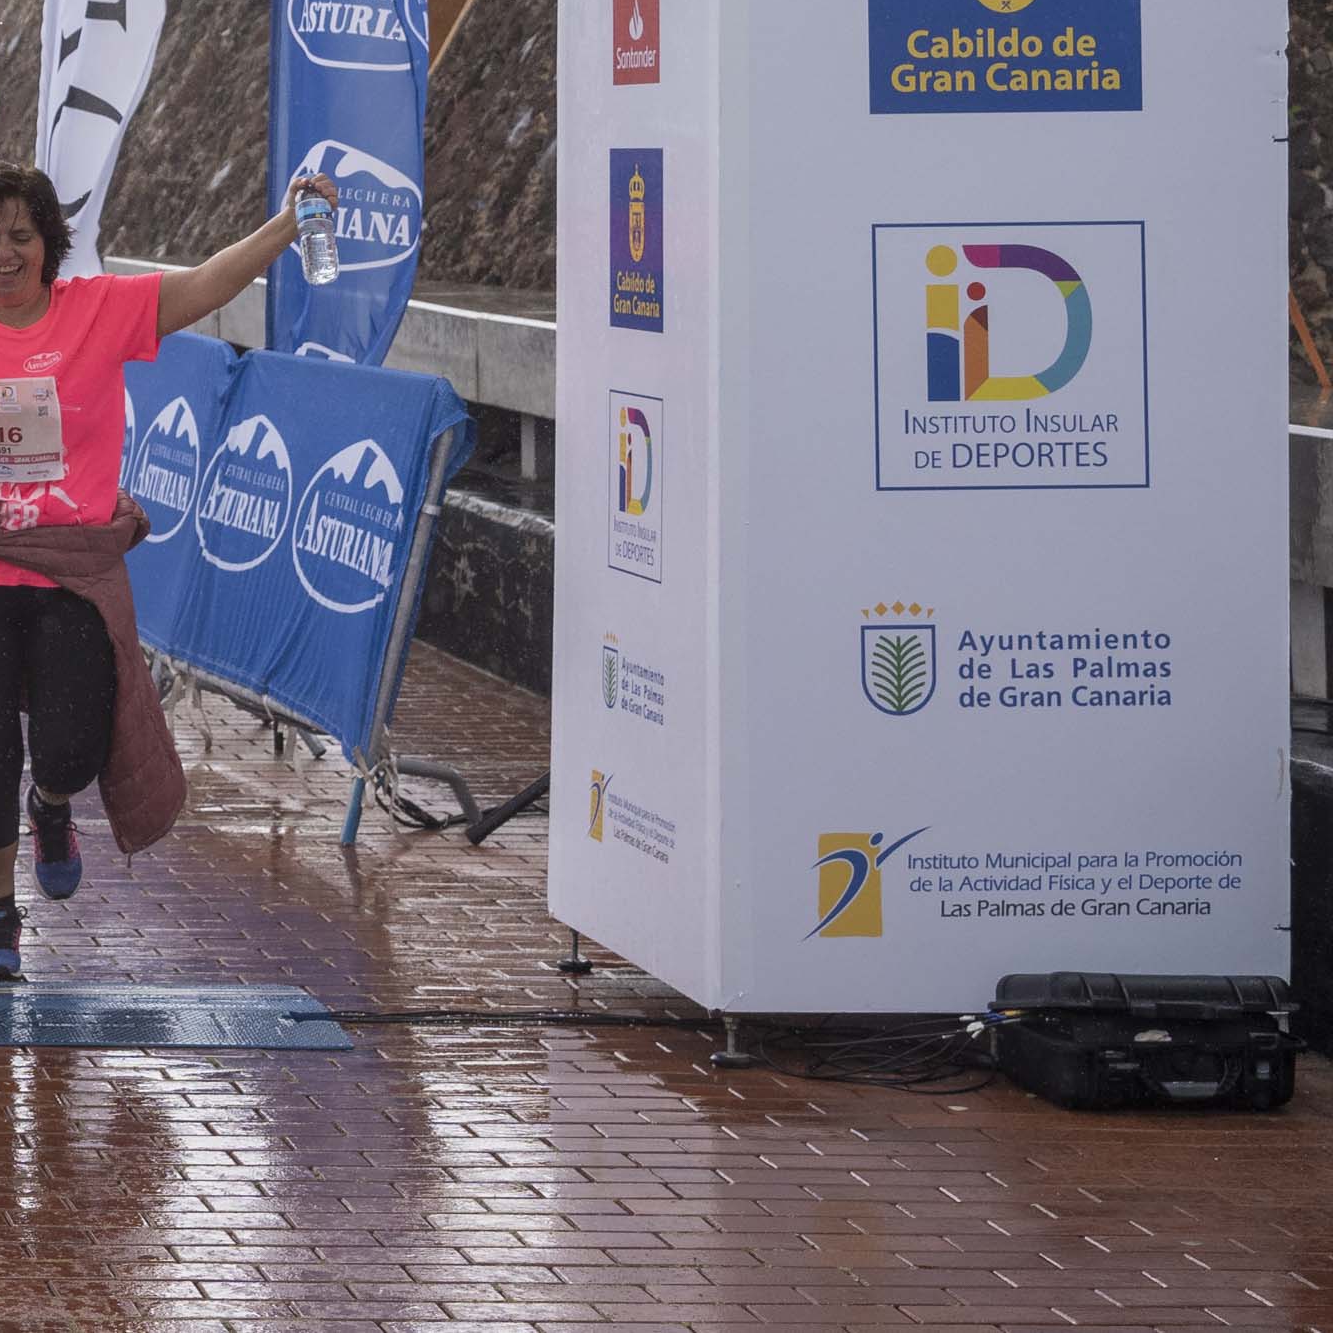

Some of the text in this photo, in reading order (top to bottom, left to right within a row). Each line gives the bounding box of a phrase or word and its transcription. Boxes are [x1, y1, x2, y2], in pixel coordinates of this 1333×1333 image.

[907, 27, 1096, 58] Cabildo de
[616, 46, 656, 70] Santander
[892, 61, 1120, 92] Gran Canaria
[905, 408, 1118, 434] INSTITUTO INSULAR
[915, 442, 1107, 468] DE DEPORTES
[134, 442, 191, 511] ASTURIANA
[297, 489, 395, 588] ASTURIANA
[958, 628, 1170, 656] Ayuntamiento
[959, 656, 1171, 679] de Las Palmas
[960, 684, 1171, 707] de Gran Canaria
[908, 851, 1242, 872] Instituto Municipal para la Promoción
[910, 874, 1241, 895] de la Actividad Física y el Deporte de
[941, 898, 1210, 917] Las Palmas de Gran Canaria
